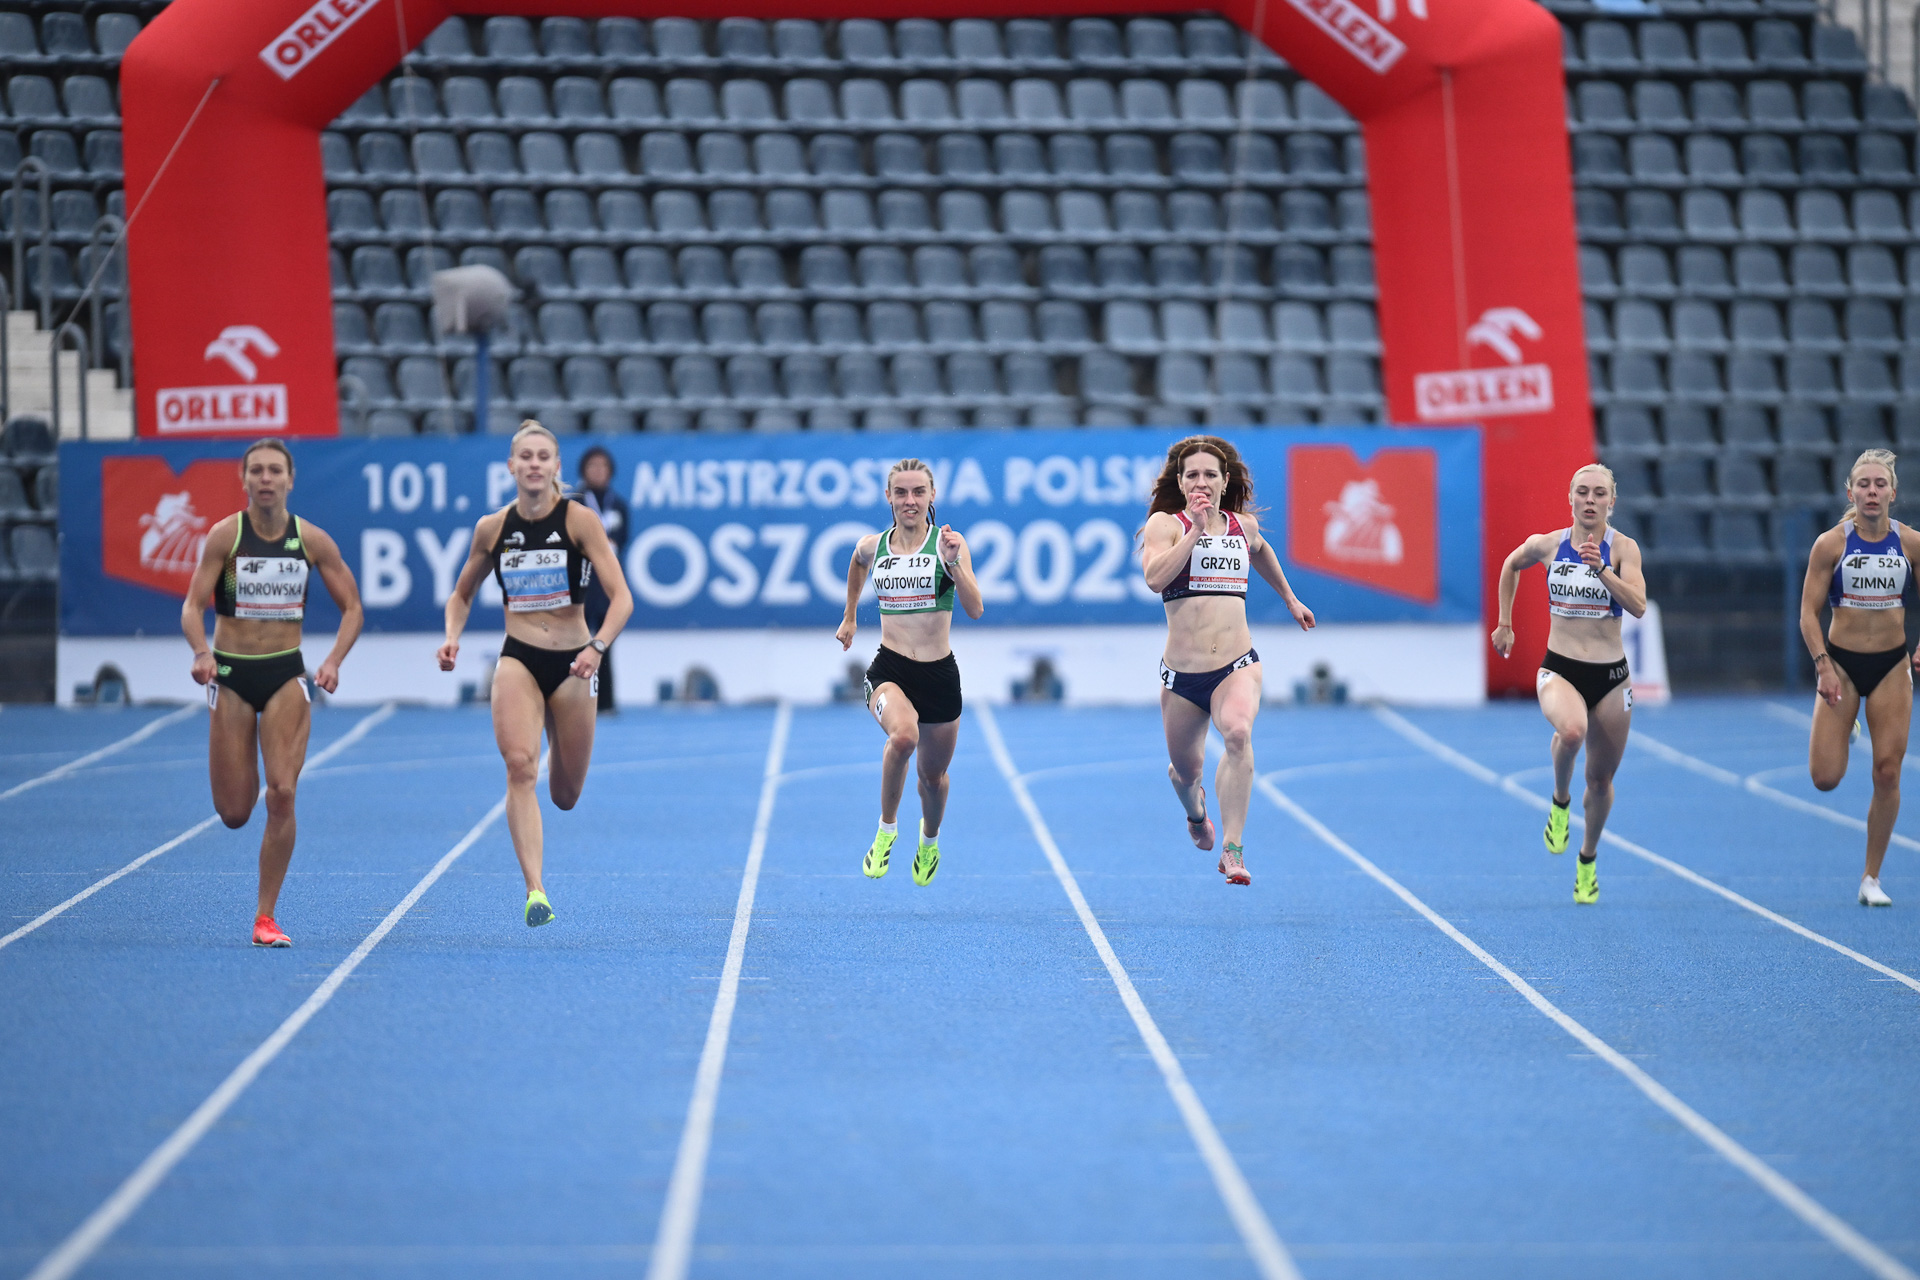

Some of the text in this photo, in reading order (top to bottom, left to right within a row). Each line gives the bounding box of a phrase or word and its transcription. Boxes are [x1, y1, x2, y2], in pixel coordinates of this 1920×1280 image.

[276, 0, 366, 65] ORLE
[1427, 379, 1540, 407] ORLEN
[164, 393, 276, 422] ORLEN
[362, 461, 470, 512] 101.
[1003, 455, 1166, 507] POLSK
[1221, 538, 1242, 550] 561
[536, 552, 560, 565] 363
[877, 556, 931, 570] 4F 119
[1200, 556, 1241, 571] GRZYB
[1846, 556, 1901, 569] 4F 524
[278, 561, 300, 574] 147
[1553, 563, 1578, 577] 4F
[237, 581, 303, 597] HOROWSKA
[504, 572, 567, 590] BUKOWIECKA
[873, 574, 932, 590] WÓJTOWICZ
[1851, 576, 1896, 589] ZIMNA
[1550, 583, 1609, 600] DZIAMSKA
[1161, 669, 1169, 686] 4
[209, 685, 218, 706] 7
